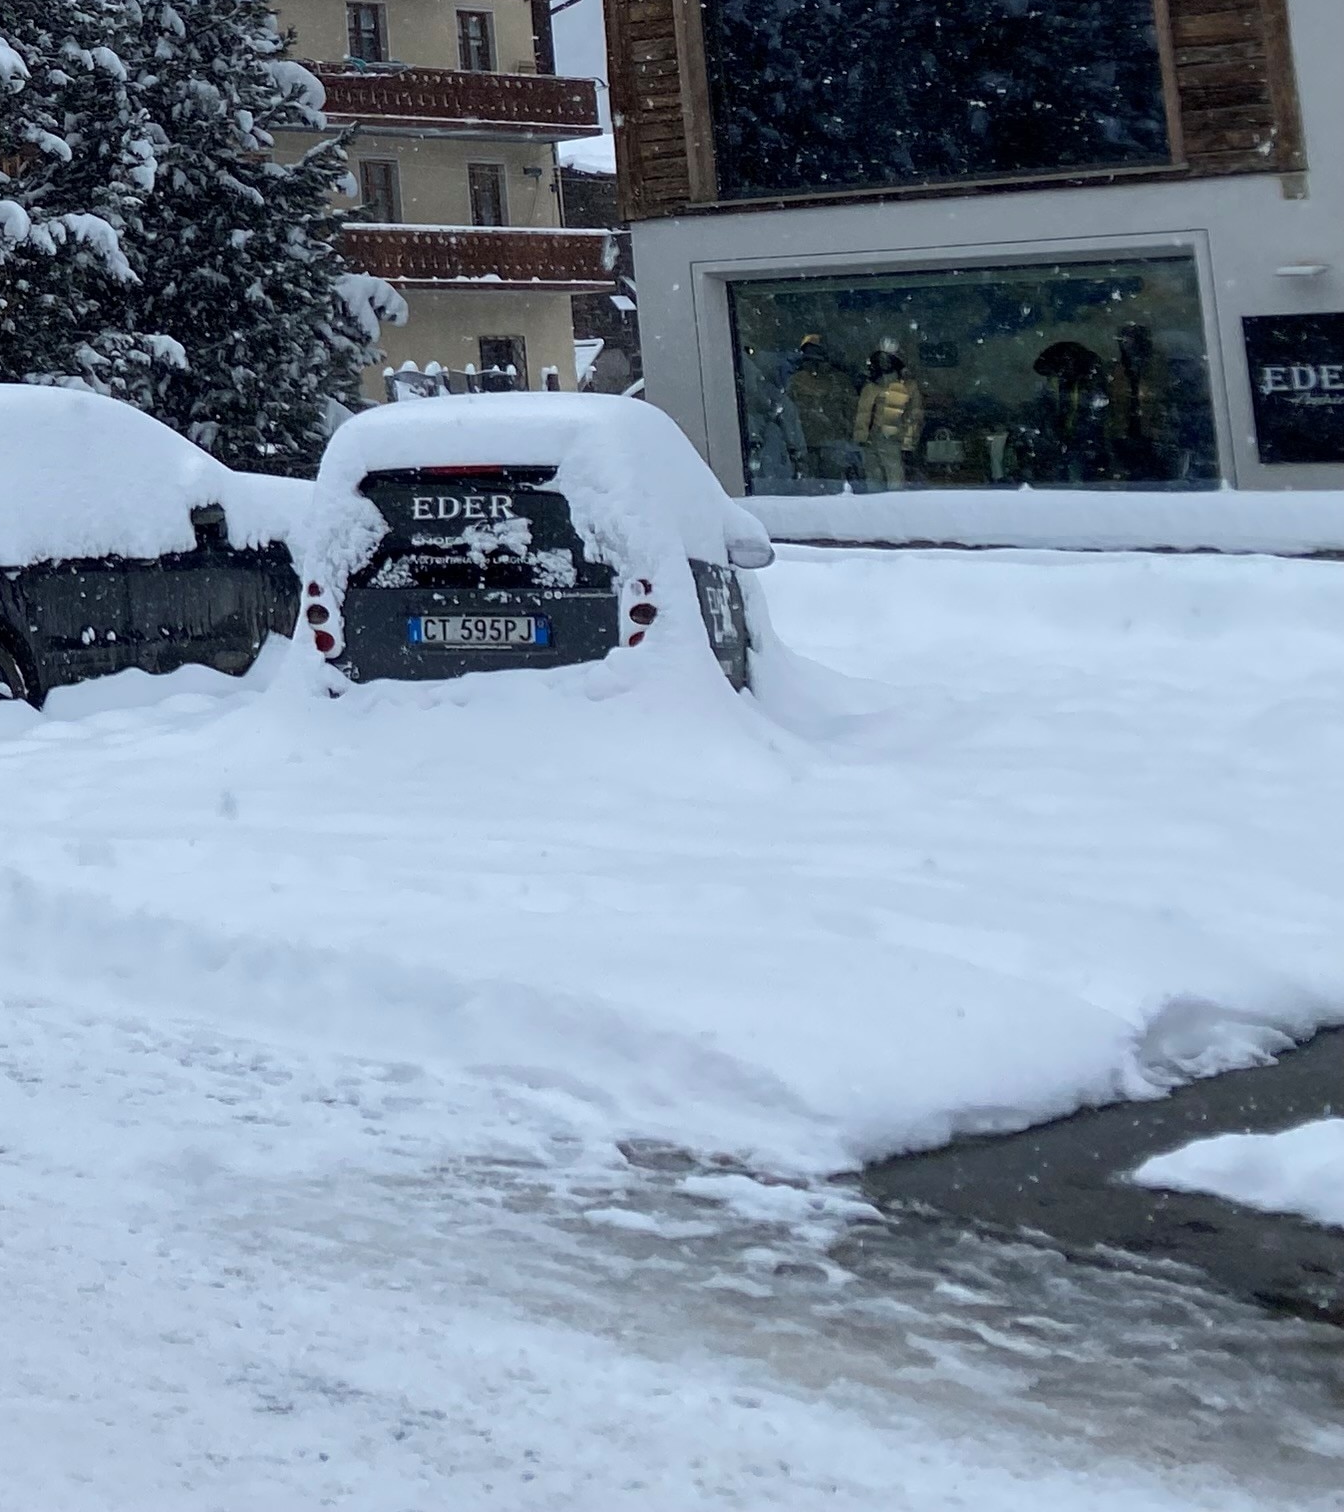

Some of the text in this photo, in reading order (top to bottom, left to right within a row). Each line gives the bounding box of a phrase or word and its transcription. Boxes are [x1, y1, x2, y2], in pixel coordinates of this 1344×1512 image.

[411, 494, 513, 520] EDER
[424, 618, 451, 641] CT
[460, 618, 532, 641] 595PJ
